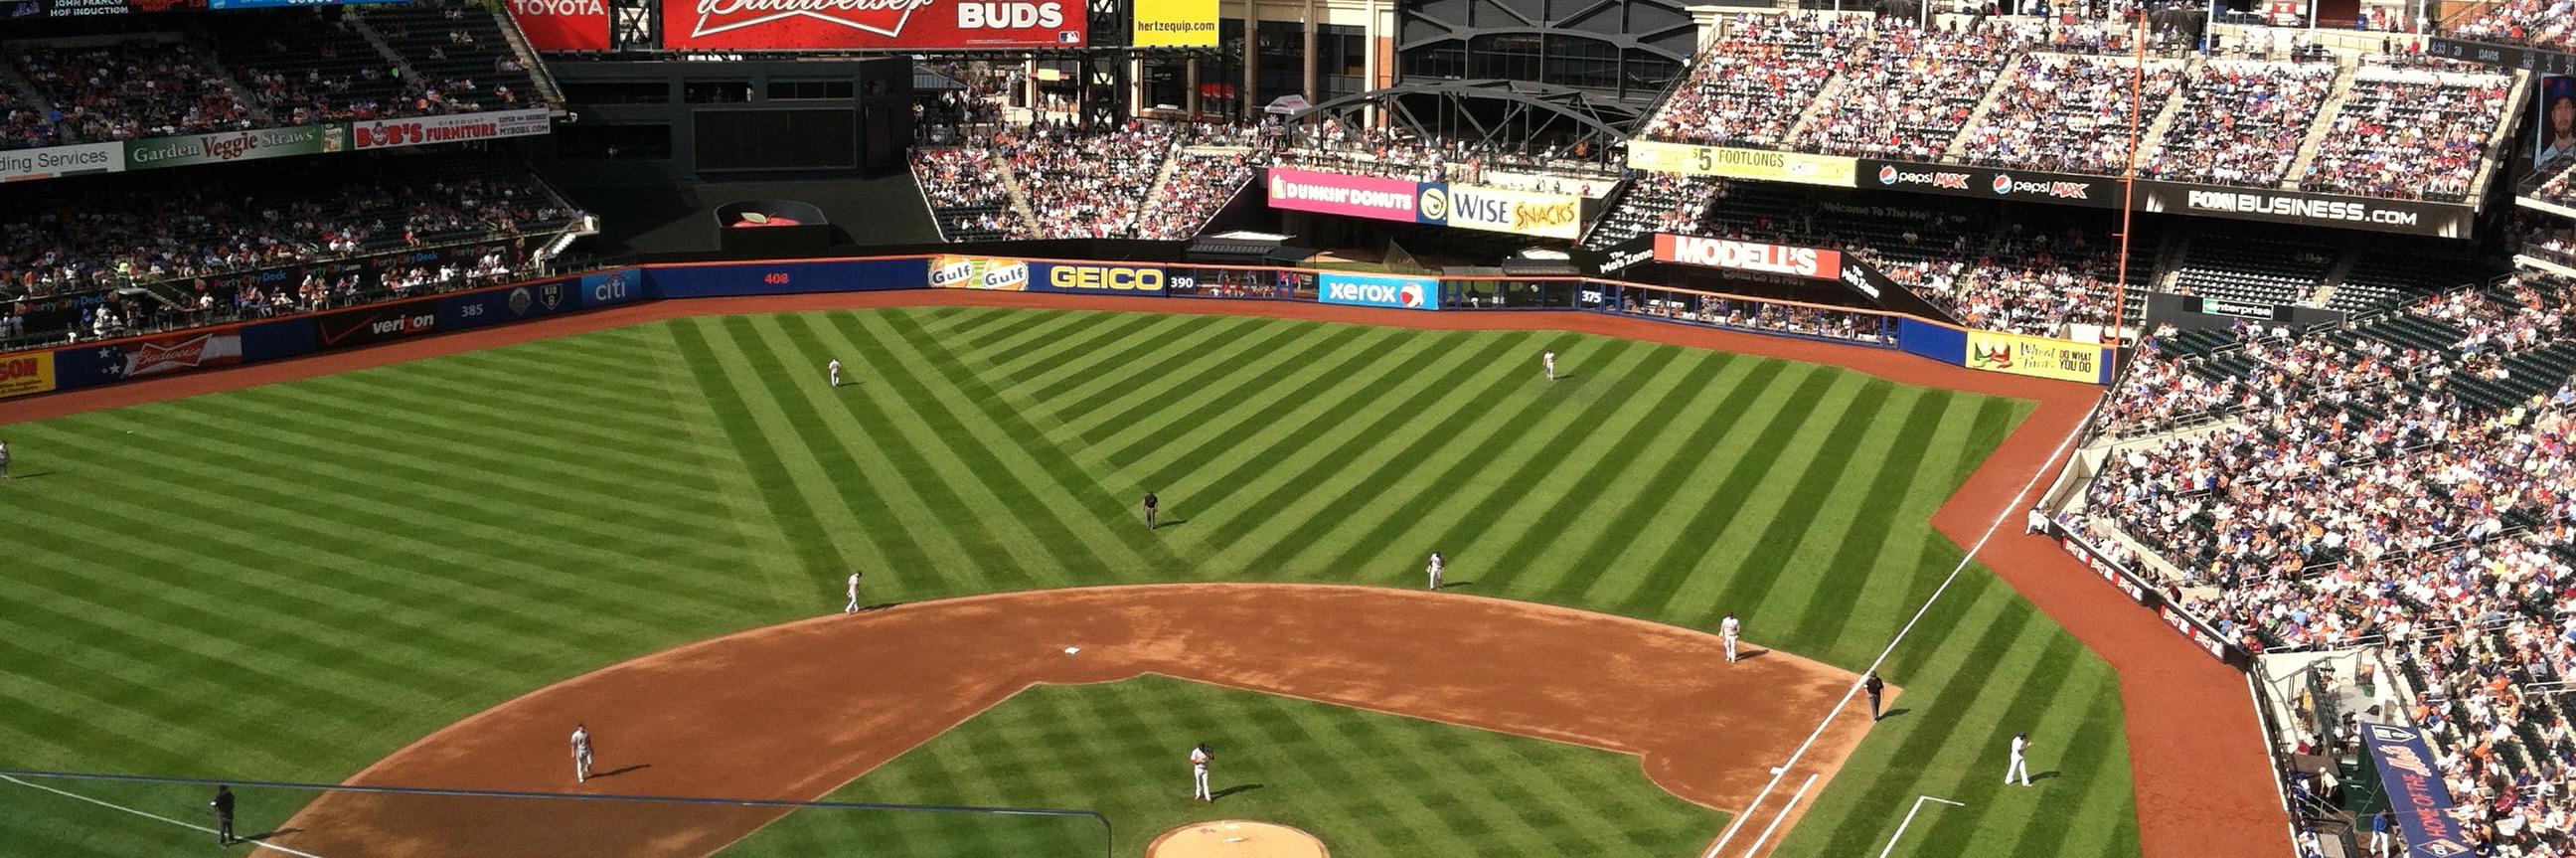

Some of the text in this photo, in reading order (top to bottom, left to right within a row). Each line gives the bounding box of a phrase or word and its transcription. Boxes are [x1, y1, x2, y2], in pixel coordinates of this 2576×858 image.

[73, 6, 129, 16] INDUCTION
[514, 0, 604, 16] TOYOTA
[958, 2, 1063, 29] BUDS
[1138, 20, 1215, 34] hertzequip.com
[2479, 48, 2499, 61] DAVIS
[356, 121, 423, 147] BOB'S
[425, 123, 497, 142] FURNITURE
[133, 128, 314, 163] Garden Veggie Straws
[38, 150, 108, 169] Services
[1718, 149, 1785, 168] FOOTLONGS
[1898, 171, 1971, 190] pepsi MAX
[1287, 182, 1412, 211] DUNKIN' DONUTS
[2012, 181, 2090, 200] pepsi MAX
[1454, 192, 1576, 229] WISE SNACKS
[1624, 249, 1654, 265] Zone
[1675, 236, 1818, 277] MODELL'S
[932, 264, 971, 283] Gulf
[985, 266, 1024, 286] Gulf
[1050, 264, 1164, 290] GEICO
[1170, 277, 1194, 288] 390
[595, 277, 626, 301] citi
[1330, 282, 1396, 303] xerox
[1581, 290, 1602, 303] 375
[461, 303, 484, 318] 385
[2204, 301, 2272, 316] nterprise
[372, 312, 434, 335] verizon
[2059, 359, 2091, 373] YOU DO
[2072, 351, 2092, 362] WHAT
